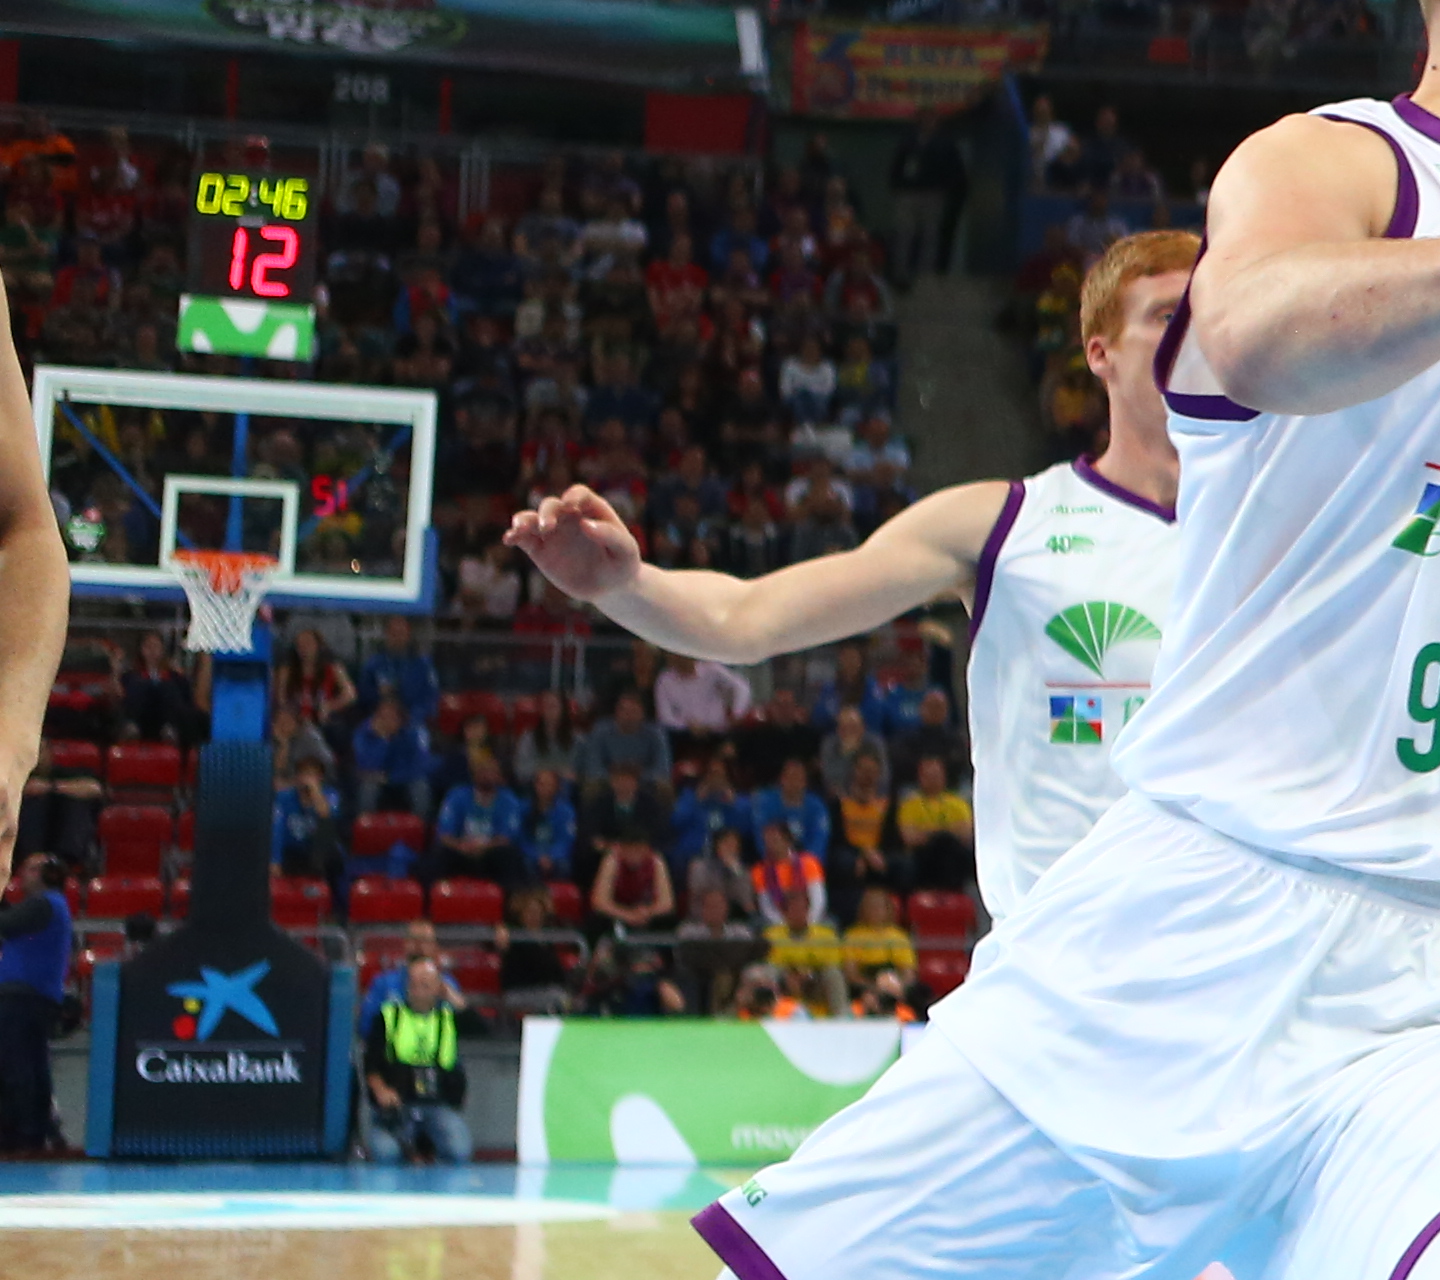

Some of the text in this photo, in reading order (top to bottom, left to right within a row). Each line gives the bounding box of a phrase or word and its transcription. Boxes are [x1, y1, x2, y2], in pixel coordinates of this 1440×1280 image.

[229, 225, 299, 297] 12
[136, 1048, 302, 1084] CaixaBank
[731, 1124, 812, 1151] mov
